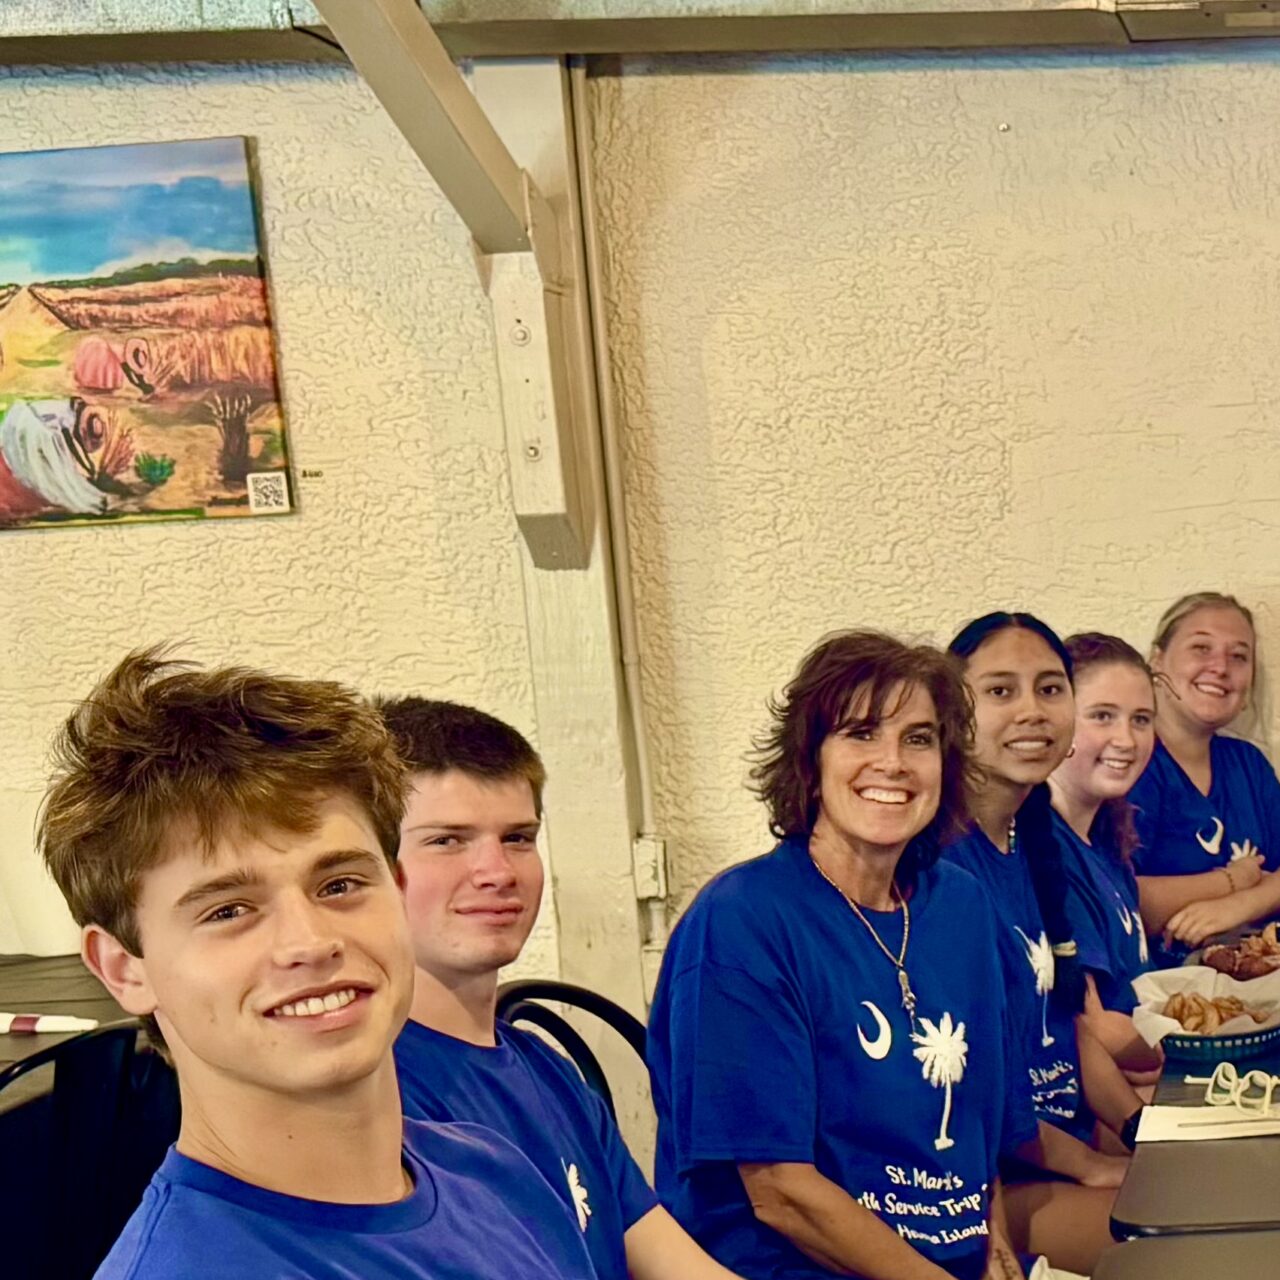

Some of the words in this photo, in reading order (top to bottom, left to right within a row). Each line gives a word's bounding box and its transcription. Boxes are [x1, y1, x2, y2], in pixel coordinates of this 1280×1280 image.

[885, 1165, 912, 1186] St.
[913, 1167, 964, 1191] Mark's
[884, 1192, 941, 1217] Service
[938, 1192, 981, 1216] Trip
[939, 1219, 990, 1244] Island
